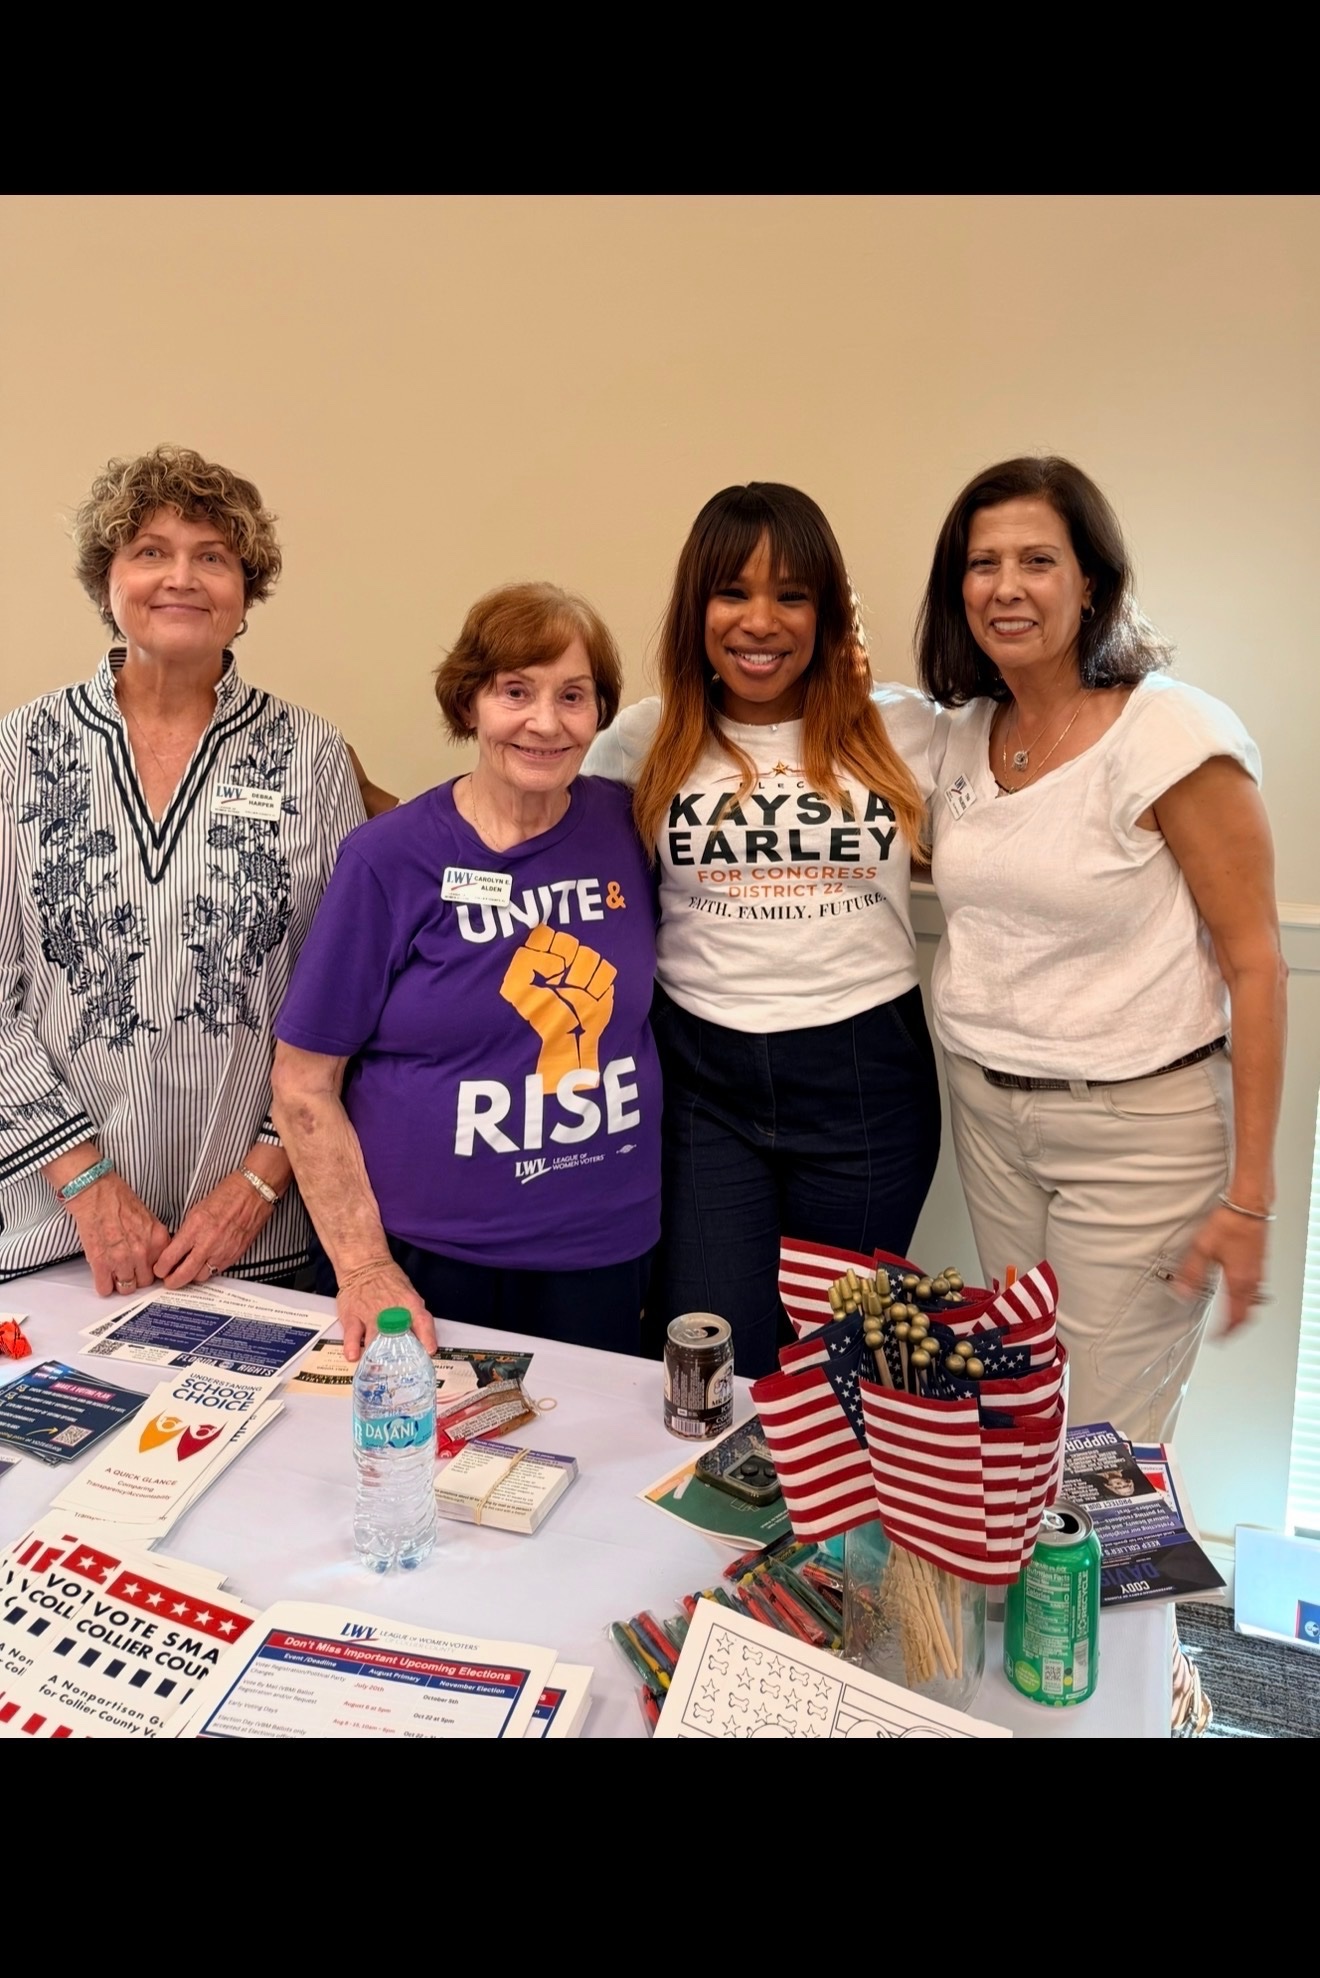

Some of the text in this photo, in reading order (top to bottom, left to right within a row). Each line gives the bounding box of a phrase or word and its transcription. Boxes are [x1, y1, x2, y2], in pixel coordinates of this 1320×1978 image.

[216, 785, 243, 799] LWV
[248, 800, 274, 808] HARPER
[668, 790, 896, 828] KAYSIA
[668, 827, 899, 866] EARLEY
[447, 870, 473, 885] LWV
[474, 875, 503, 884] CAROLYN
[697, 866, 877, 883] FOR CONGRESS
[728, 882, 843, 898] DISTRICT 22
[456, 878, 626, 943] UNITE &
[738, 906, 812, 920] FAMILY.
[454, 1056, 640, 1157] RISE
[515, 1158, 546, 1177] LWV
[552, 1154, 605, 1170] WOMEN VOTERS
[553, 1154, 579, 1164] LEAGUE
[237, 1364, 275, 1377] RIGHTS
[181, 1378, 255, 1401] SCHOOL
[190, 1373, 262, 1392] UNDERSTANDING
[172, 1388, 254, 1411] CHOICE
[365, 1421, 415, 1444] DASANI
[1065, 1432, 1117, 1453] SUPPOR
[113, 1469, 140, 1480] QUICK
[142, 1477, 178, 1486] GLANCE
[117, 1480, 154, 1492] Comparing
[1103, 1499, 1133, 1508] PROTECT
[1104, 1540, 1161, 1556] KEEP COLLIER'S
[1101, 1562, 1160, 1587] DAVIS
[46, 1573, 95, 1605] VOT
[1081, 1570, 1089, 1618] RECYCLE
[1120, 1580, 1151, 1594] CODY
[28, 1590, 75, 1620] COLL
[93, 1601, 220, 1665] VOTE SMA
[340, 1622, 378, 1640] LWV
[379, 1630, 408, 1641] LEAGUE
[419, 1636, 449, 1647] WOMEN
[449, 1641, 479, 1651] VOTERS
[76, 1619, 154, 1660] COLLIER
[155, 1651, 210, 1681] COUN
[284, 1653, 303, 1662] Event
[284, 1636, 511, 1681] Don't Miss Important Upcoming Elections
[250, 1668, 275, 1677] Changes
[255, 1661, 346, 1682] Voter Registration/Political Party
[368, 1668, 421, 1683] August Primary
[243, 1678, 258, 1687] Vote
[297, 1687, 314, 1696] Ballot
[354, 1682, 368, 1690] July
[439, 1680, 505, 1695] November Election
[47, 1674, 58, 1684] A
[61, 1680, 144, 1720] Nonpartisan
[238, 1685, 318, 1705] Registration and/or Request
[423, 1694, 448, 1704] October
[39, 1684, 57, 1698] for
[59, 1693, 97, 1715] Collier
[98, 1711, 140, 1734] County
[228, 1700, 279, 1714] Early Voting Days
[343, 1700, 364, 1710] August
[413, 1712, 424, 1720] Oct
[212, 1721, 240, 1732] accepted
[217, 1714, 241, 1724] Election
[242, 1718, 254, 1727] Day
[272, 1723, 294, 1734] Ballots
[294, 1727, 307, 1736] only
